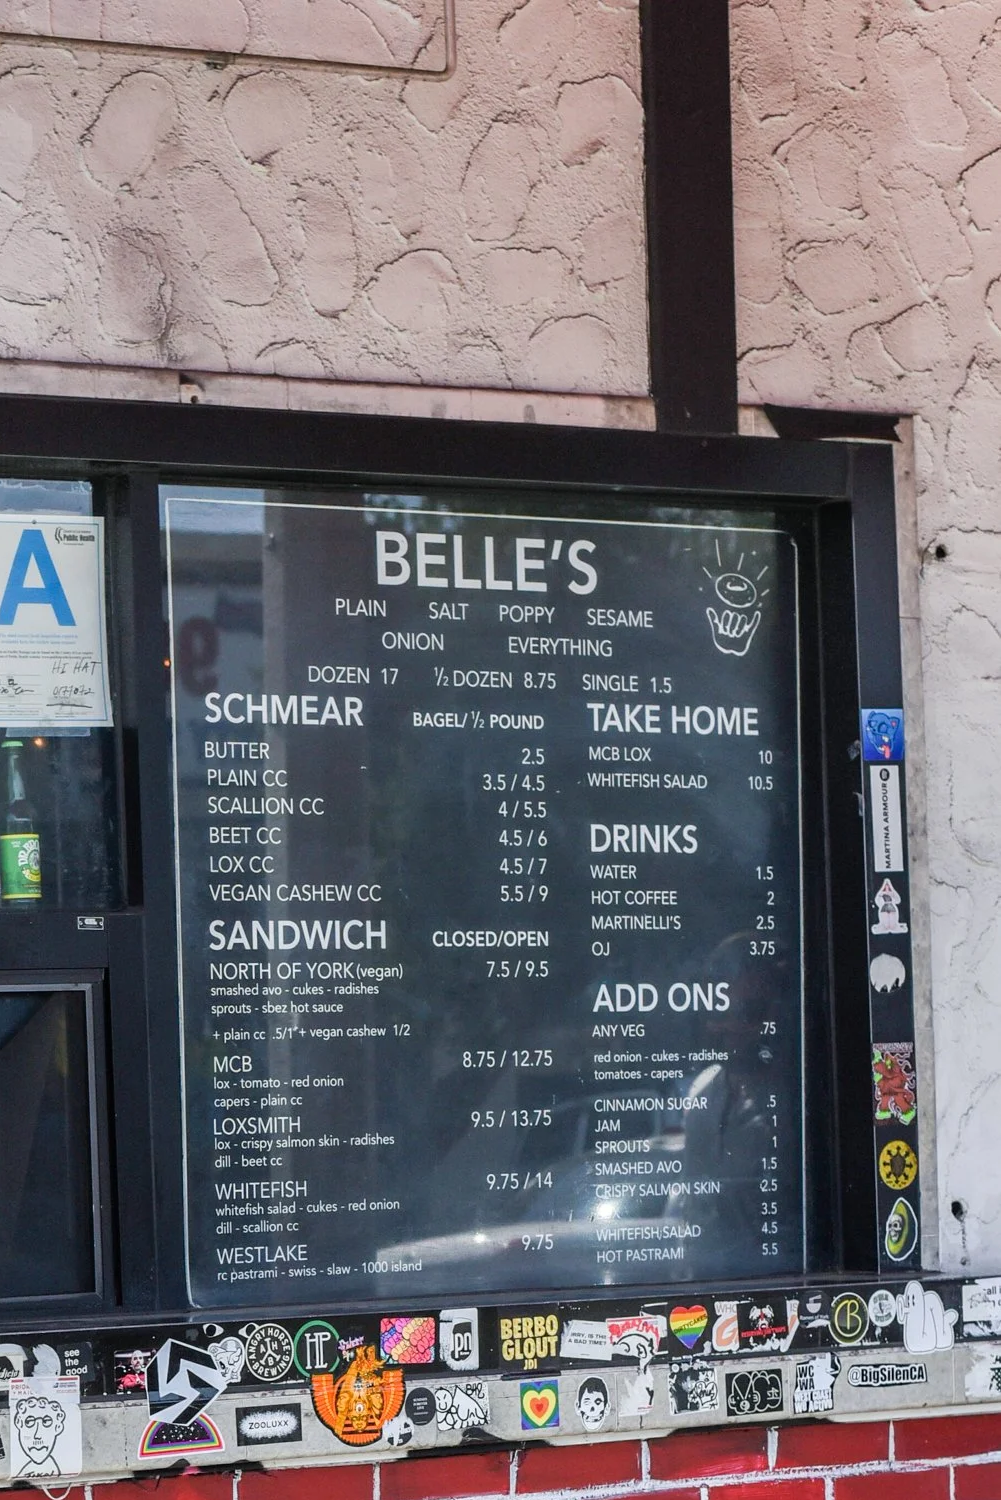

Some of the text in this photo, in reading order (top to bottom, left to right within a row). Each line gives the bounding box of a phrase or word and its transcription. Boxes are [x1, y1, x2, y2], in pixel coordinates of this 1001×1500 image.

[376, 531, 597, 594] BELLE'S
[336, 598, 653, 627] PLAIN SALT POPPY SESAME
[382, 632, 612, 656] ONION EVERYTHING
[52, 658, 102, 675] HI HAT
[309, 666, 671, 693] DOZEN 17 DOZEN 8.75 SINGLE 1.5
[205, 693, 544, 729] SCHMEAR BAGEL/ POUND
[587, 703, 758, 735] TAKE HOME
[205, 742, 269, 759] BUTTER
[522, 748, 544, 764] 2.5
[589, 746, 651, 761] MCB LOX
[759, 750, 772, 764] 10
[208, 769, 287, 787] PLAIN CC
[588, 773, 707, 788] WHITEFISH SALAD
[749, 776, 773, 790] 10.5
[208, 797, 324, 815] SCALLION CC
[881, 782, 890, 824] ARMOUR
[210, 827, 281, 844] BEET CC
[591, 824, 697, 853] DRINKS
[210, 856, 274, 873] LOX CC
[590, 865, 636, 879] WATER
[757, 866, 773, 880] 1.5
[209, 884, 381, 901] VEGAN CASHEW CC
[592, 890, 677, 905] HOT COFFEE
[592, 915, 681, 929] MARTINELLI'S
[757, 916, 774, 929] 2.5
[210, 920, 386, 950] SANDWICH
[433, 931, 548, 947] CLOSED/OPEN
[592, 942, 609, 956] OJ
[750, 941, 775, 955] 3.75
[211, 962, 402, 981] NORTH OF YORK (vegan)
[211, 982, 379, 997] smashed avo cukes radishes
[593, 983, 729, 1012] ADD ONS
[212, 1001, 343, 1016] sprouts sbez hot sauce
[592, 1024, 644, 1037] ANY VEG
[594, 1049, 728, 1062] red onion cukes radishes
[214, 1056, 252, 1072] MCB
[594, 1070, 683, 1081] tomatoes capers
[594, 1095, 708, 1112] CINNAMON SUGAR
[214, 1117, 300, 1135] LOXSMITH
[595, 1119, 620, 1132] JAM
[595, 1140, 650, 1154] SPROUTS
[595, 1160, 682, 1176] SMASHED AVO
[215, 1181, 306, 1200] WHITEFISH
[595, 1181, 721, 1199] CRISPY SALMON SKIN
[762, 1202, 777, 1215] 3.5
[596, 1224, 702, 1241] WHITEFISH SALAD
[762, 1222, 777, 1233] 4.5
[521, 1233, 554, 1250] 9.75
[762, 1243, 778, 1255] 5.5
[217, 1245, 307, 1265] WESTLAKE
[597, 1247, 683, 1263] HOT PASTRAMI
[231, 1257, 422, 1283] pastrami swiss slaw 1000 island
[500, 1314, 559, 1340] BERBO
[249, 1327, 291, 1360] ANGRY HORSE
[501, 1336, 558, 1361] GLOUT
[64, 1349, 80, 1358] see
[65, 1357, 79, 1366] the
[66, 1365, 88, 1376] good
[253, 1355, 290, 1377] BREWING
[523, 1358, 538, 1370] JDI
[799, 1378, 815, 1391] WA
[248, 1417, 289, 1431] ZOOLUXX
